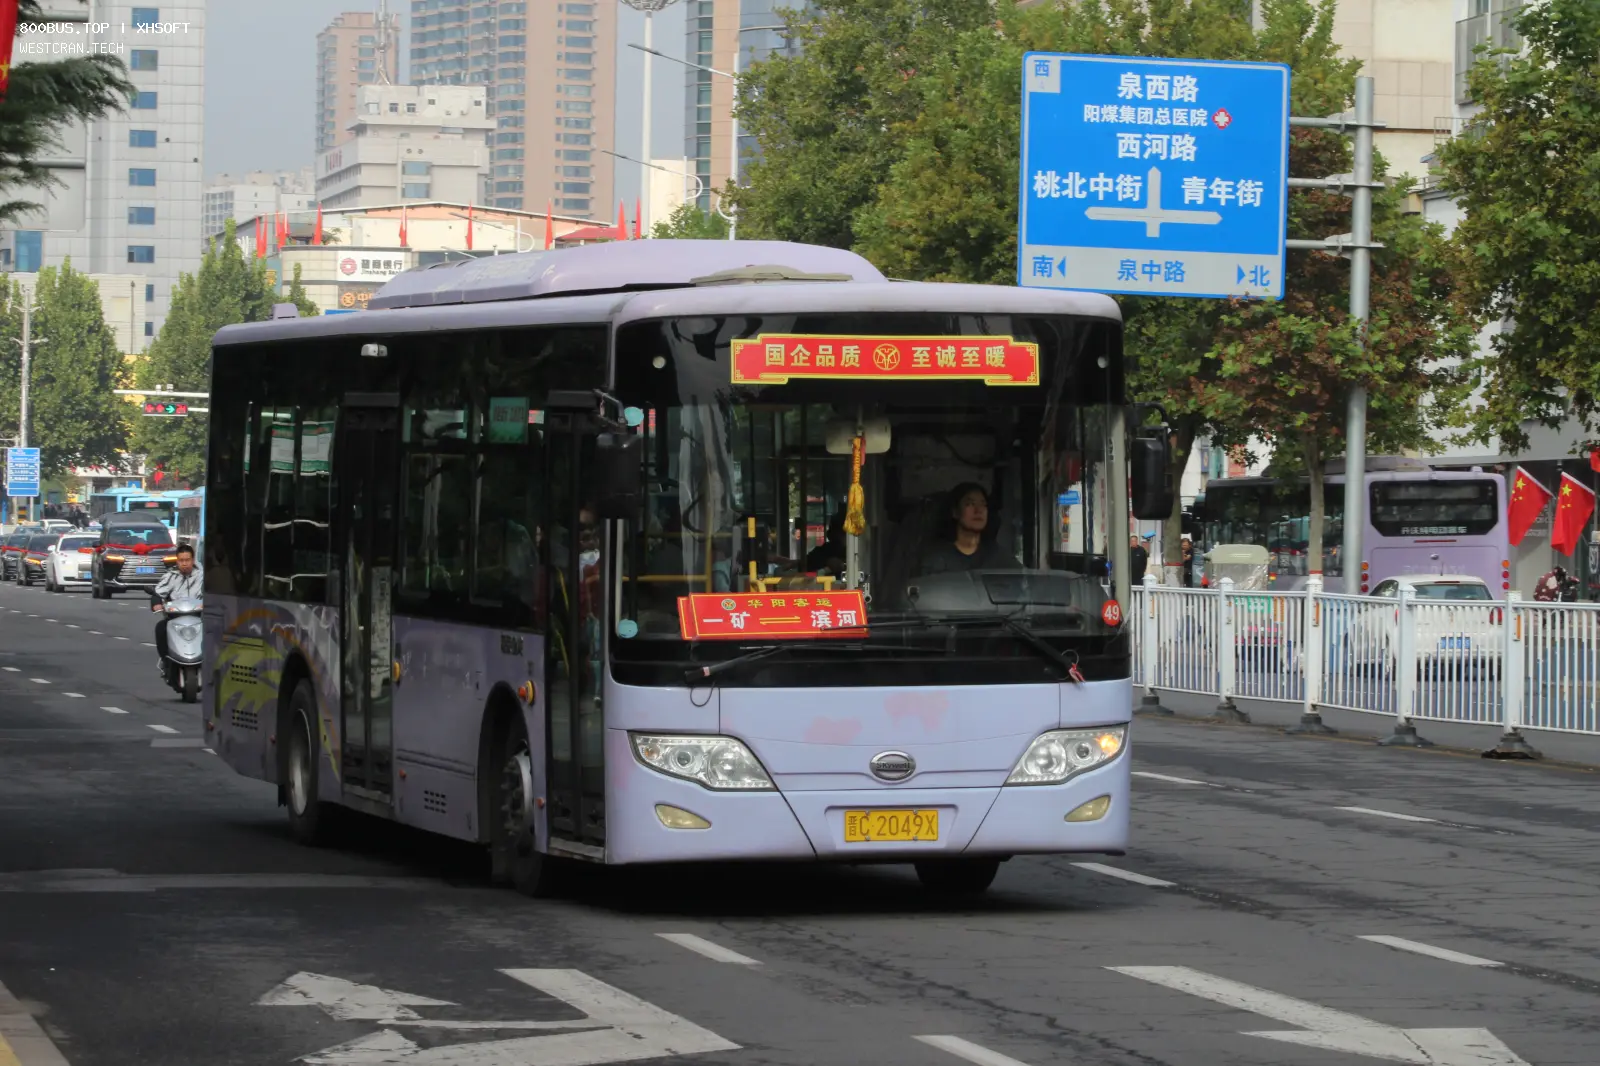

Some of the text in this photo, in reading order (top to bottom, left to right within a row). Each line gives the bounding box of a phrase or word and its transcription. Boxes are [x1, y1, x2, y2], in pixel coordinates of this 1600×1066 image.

[1034, 60, 1051, 77] 西
[1117, 72, 1199, 102] 泉西路
[1083, 104, 1208, 127] 阳煤集团总医院
[1116, 132, 1198, 161] 西河路
[1033, 171, 1143, 201] 桃北中街
[1181, 177, 1264, 207] 青年街
[1032, 255, 1054, 278] 南
[1117, 259, 1186, 283] 泉中路
[1249, 265, 1271, 287] 北
[764, 343, 1006, 369] 国企品质 至诚至暖
[747, 598, 833, 608] 华阳客运
[1104, 605, 1120, 620] 49
[702, 609, 857, 630] 一矿 滨河
